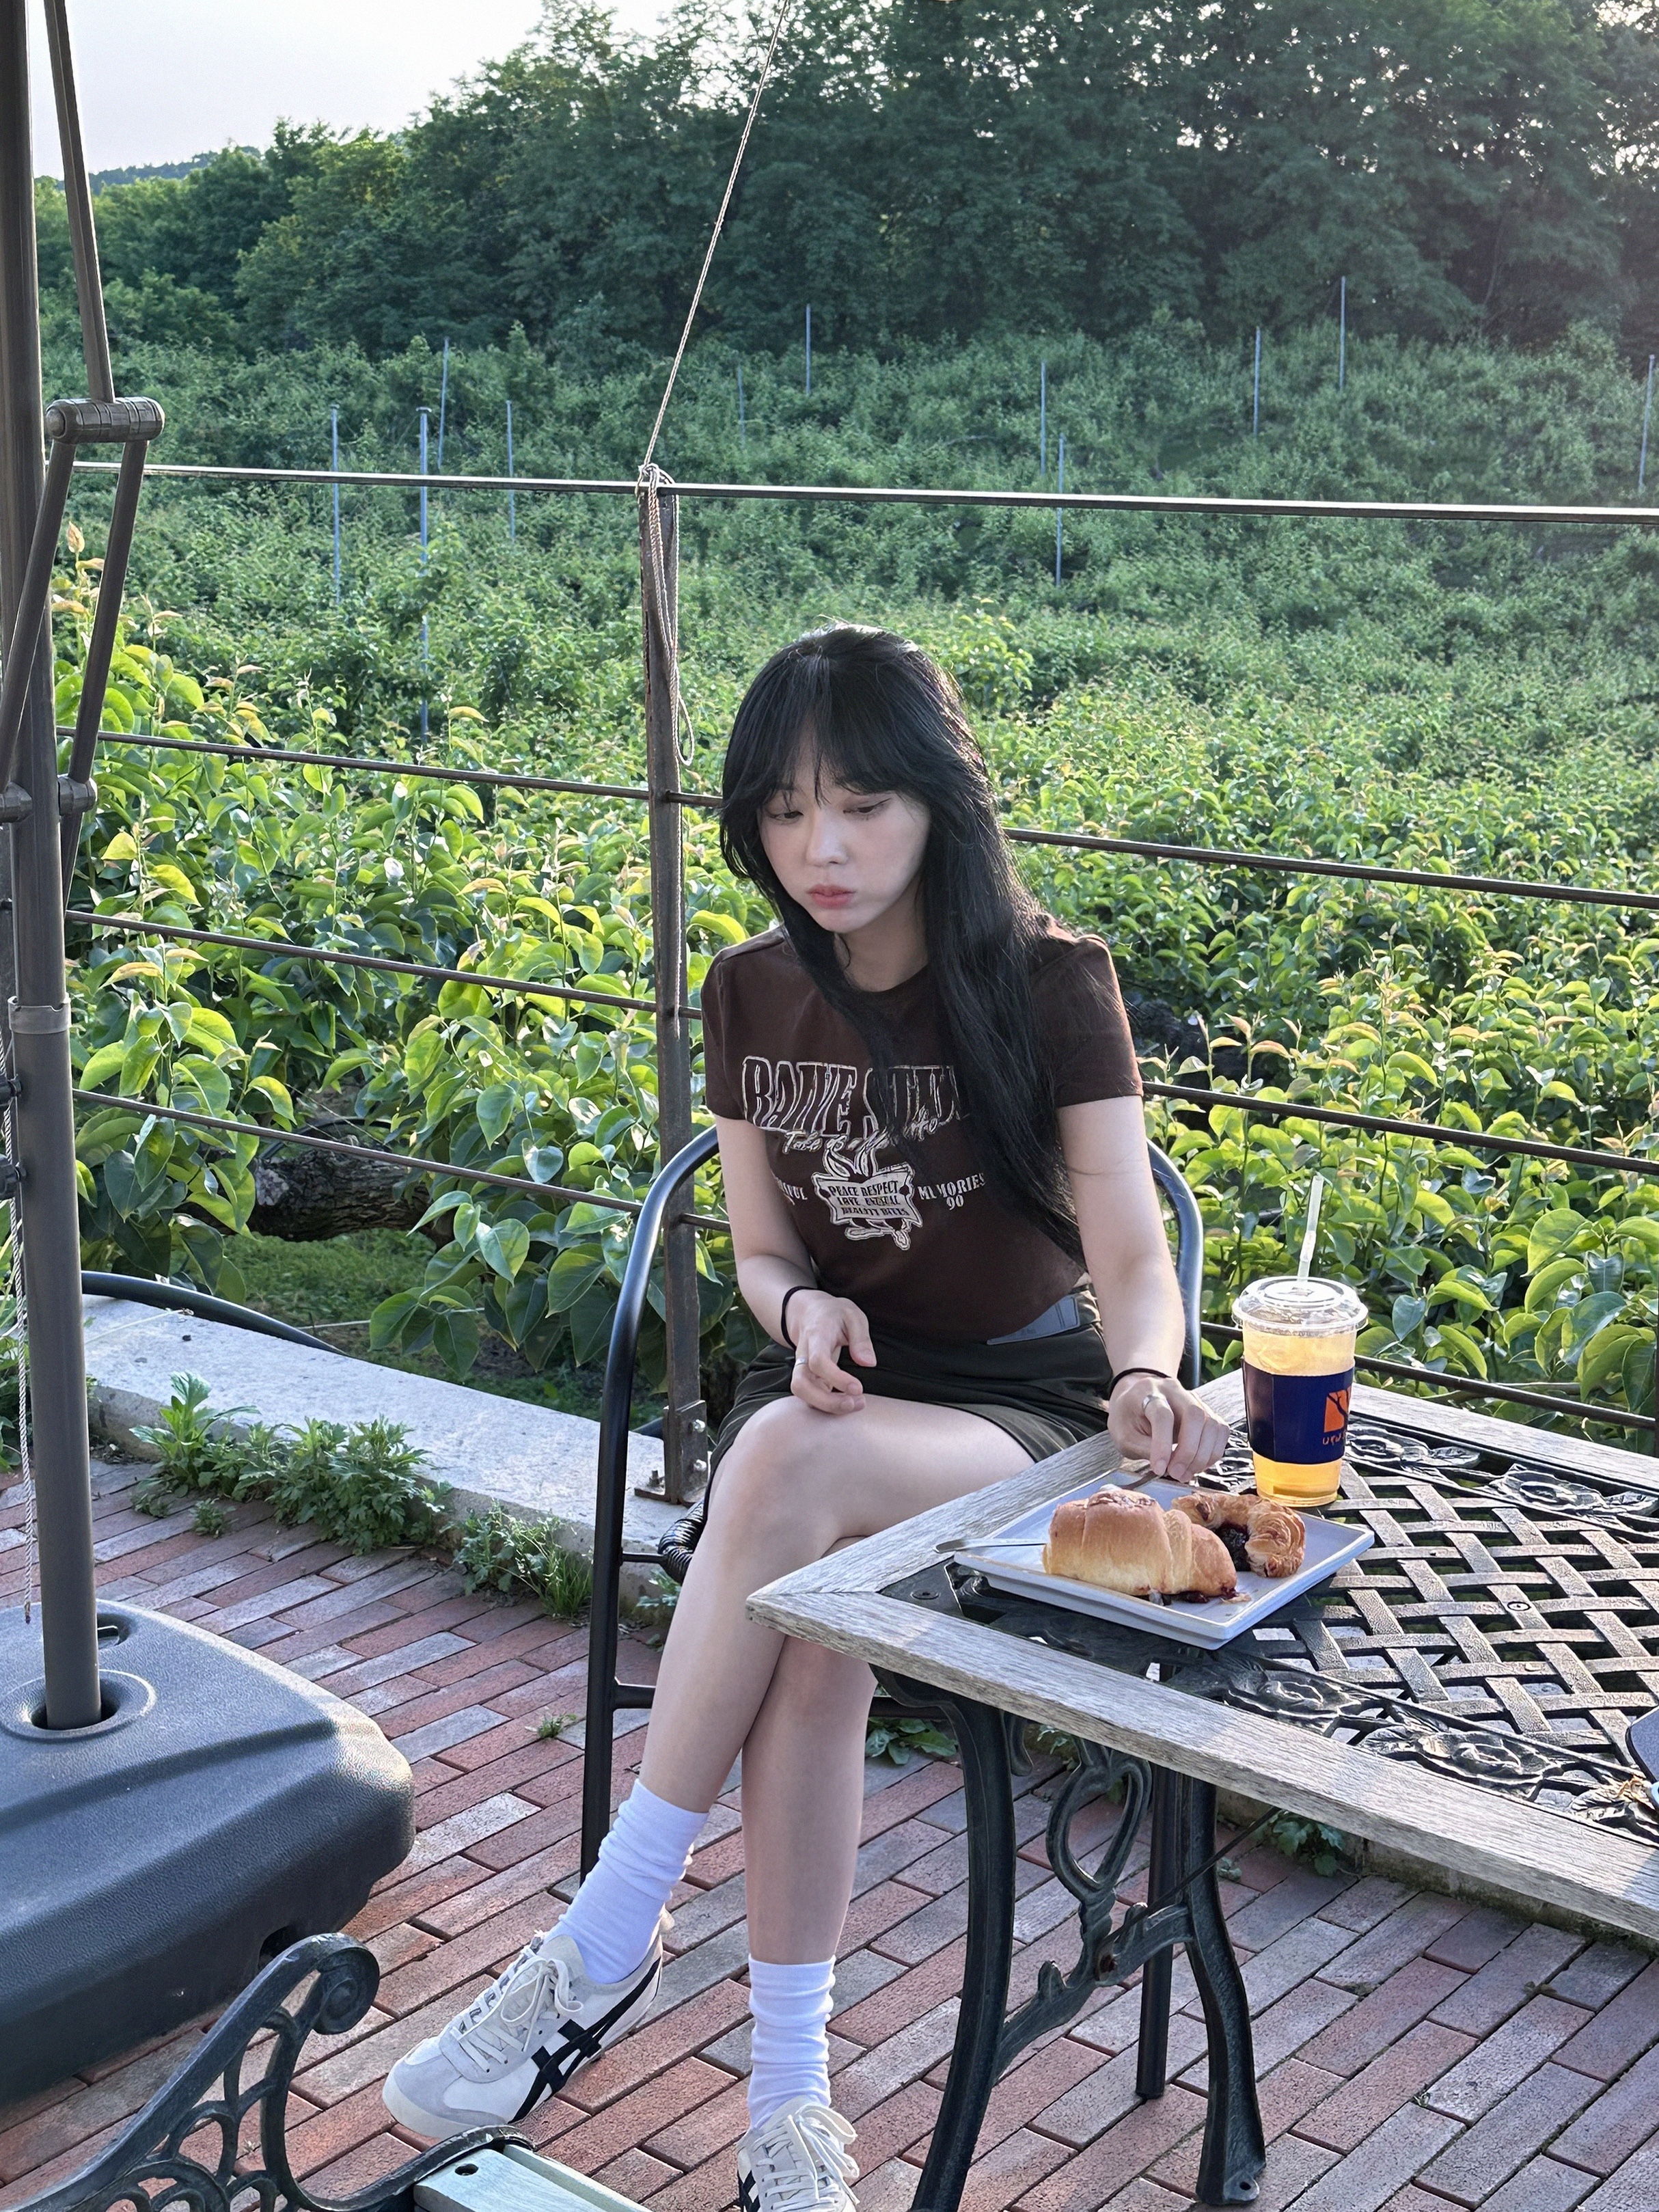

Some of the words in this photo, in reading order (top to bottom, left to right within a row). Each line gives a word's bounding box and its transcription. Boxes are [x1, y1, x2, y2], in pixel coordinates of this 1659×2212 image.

[827, 1185, 860, 1197] PEACE
[860, 1180, 899, 1197] RESPECT
[946, 1194, 965, 1211] 90
